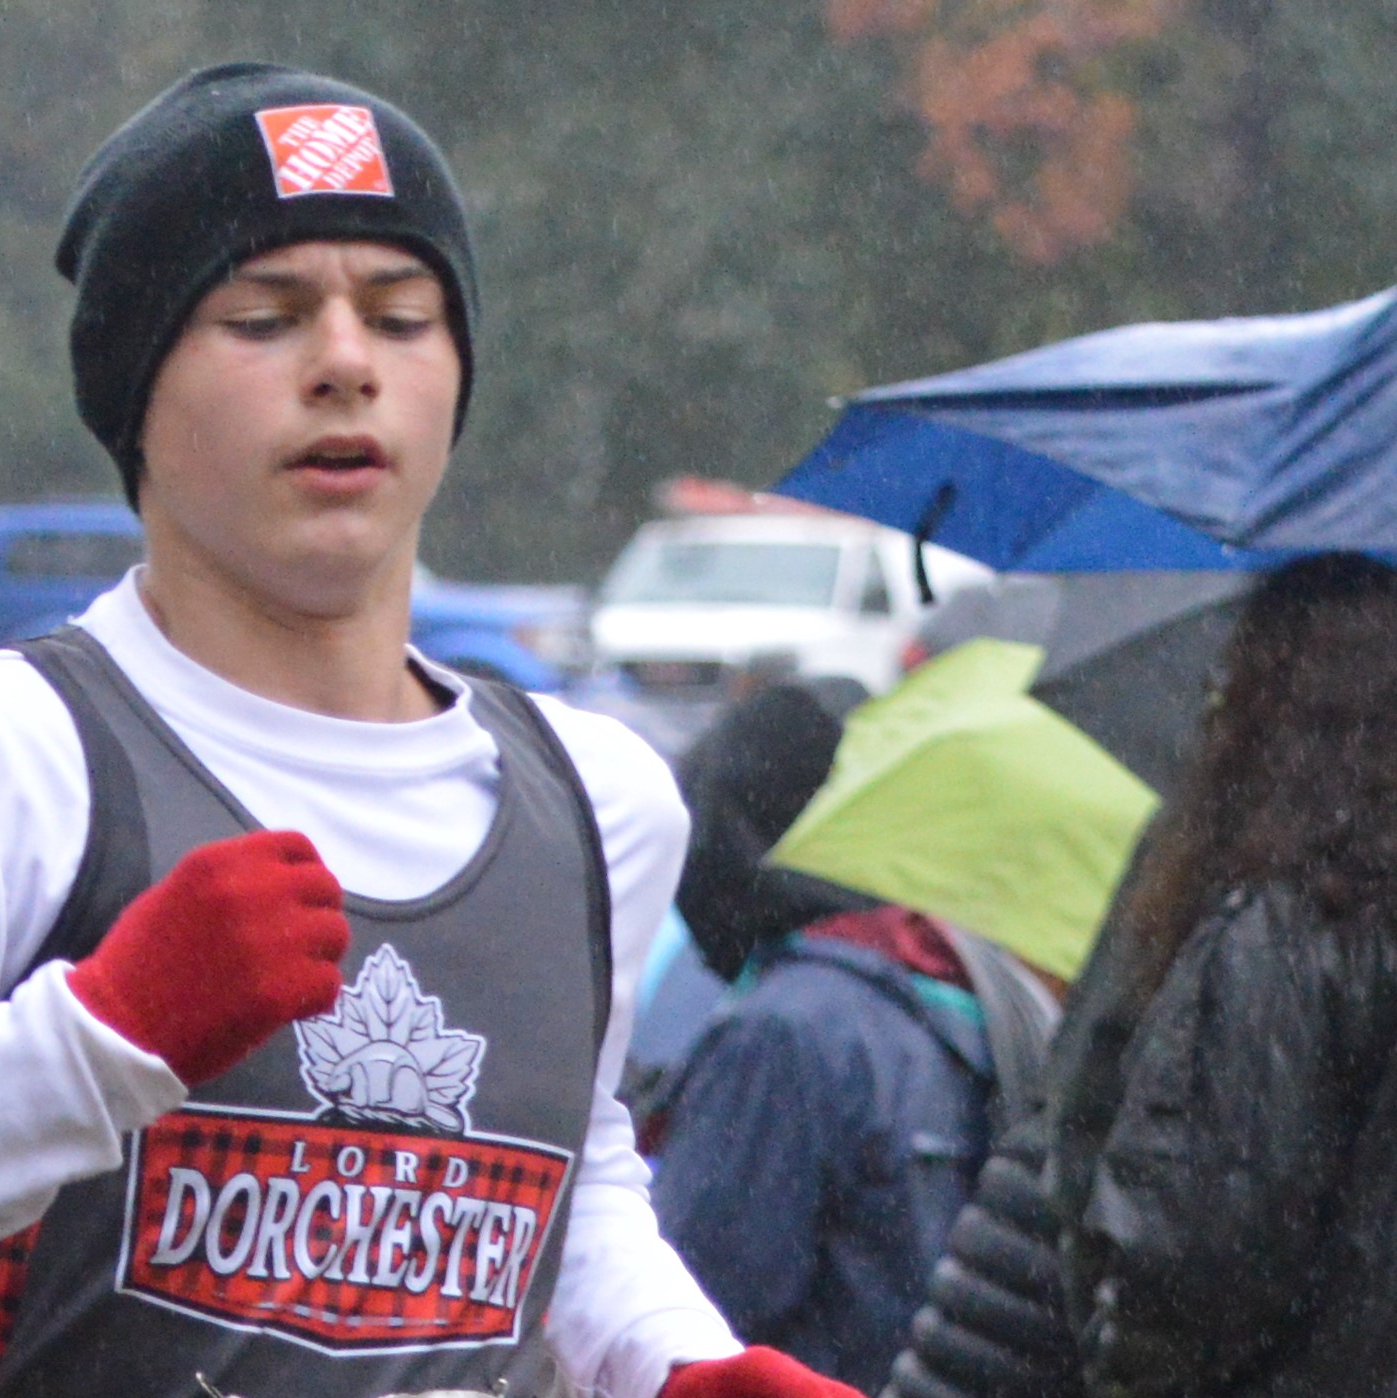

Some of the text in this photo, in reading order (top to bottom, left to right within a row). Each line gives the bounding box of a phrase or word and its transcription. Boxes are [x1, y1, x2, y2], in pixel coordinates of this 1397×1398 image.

[277, 115, 320, 147] THE
[279, 107, 372, 190] HOME
[290, 1141, 469, 1189] LORD
[149, 1167, 537, 1309] DORCHESTER
